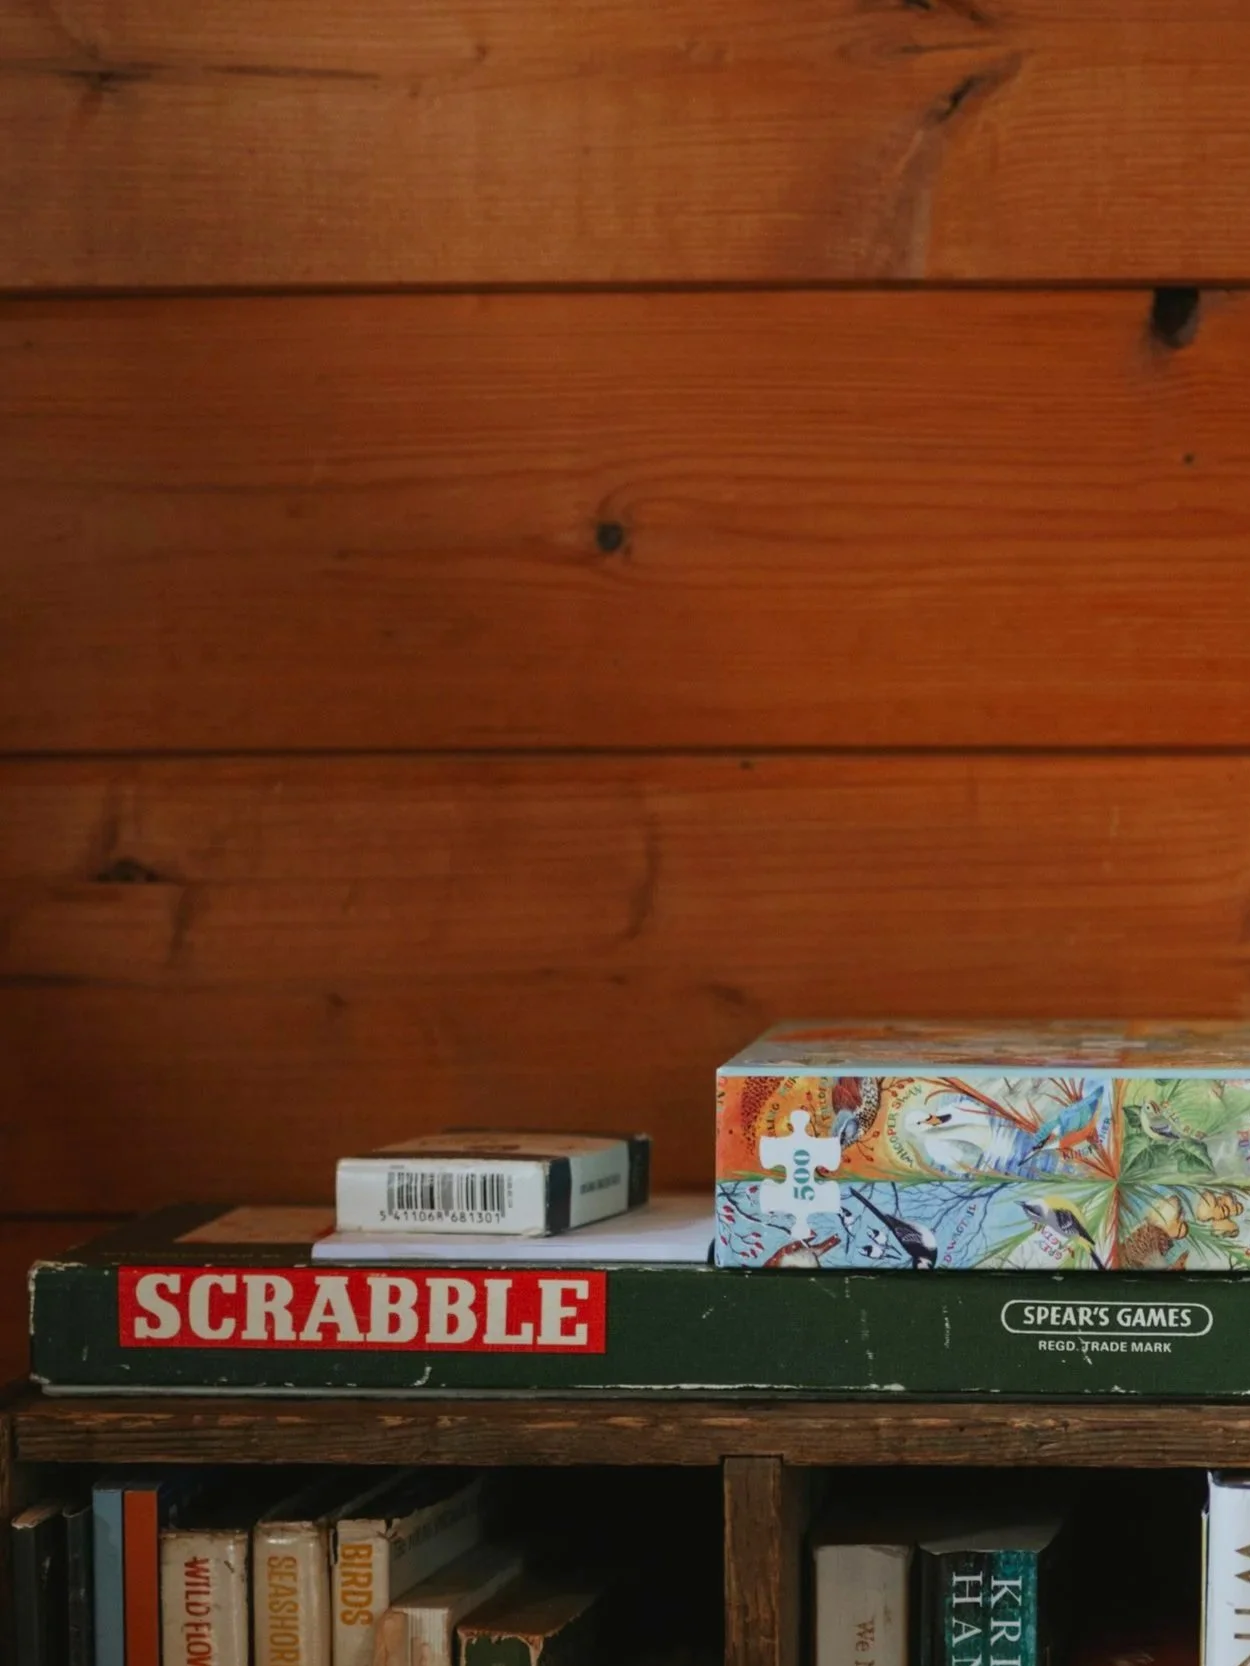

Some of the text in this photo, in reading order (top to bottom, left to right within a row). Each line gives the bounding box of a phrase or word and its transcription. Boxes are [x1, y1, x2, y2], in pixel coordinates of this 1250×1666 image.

[793, 1150, 815, 1201] 500
[380, 1211, 500, 1223] 5 681301
[133, 1272, 589, 1347] SCRABBLE
[1023, 1306, 1192, 1327] SPEAR'S GAMES
[1038, 1340, 1172, 1353] REGD. TRADE MARK
[185, 1557, 211, 1616] WILD
[340, 1543, 374, 1626] BIRDS
[855, 1620, 874, 1652] We
